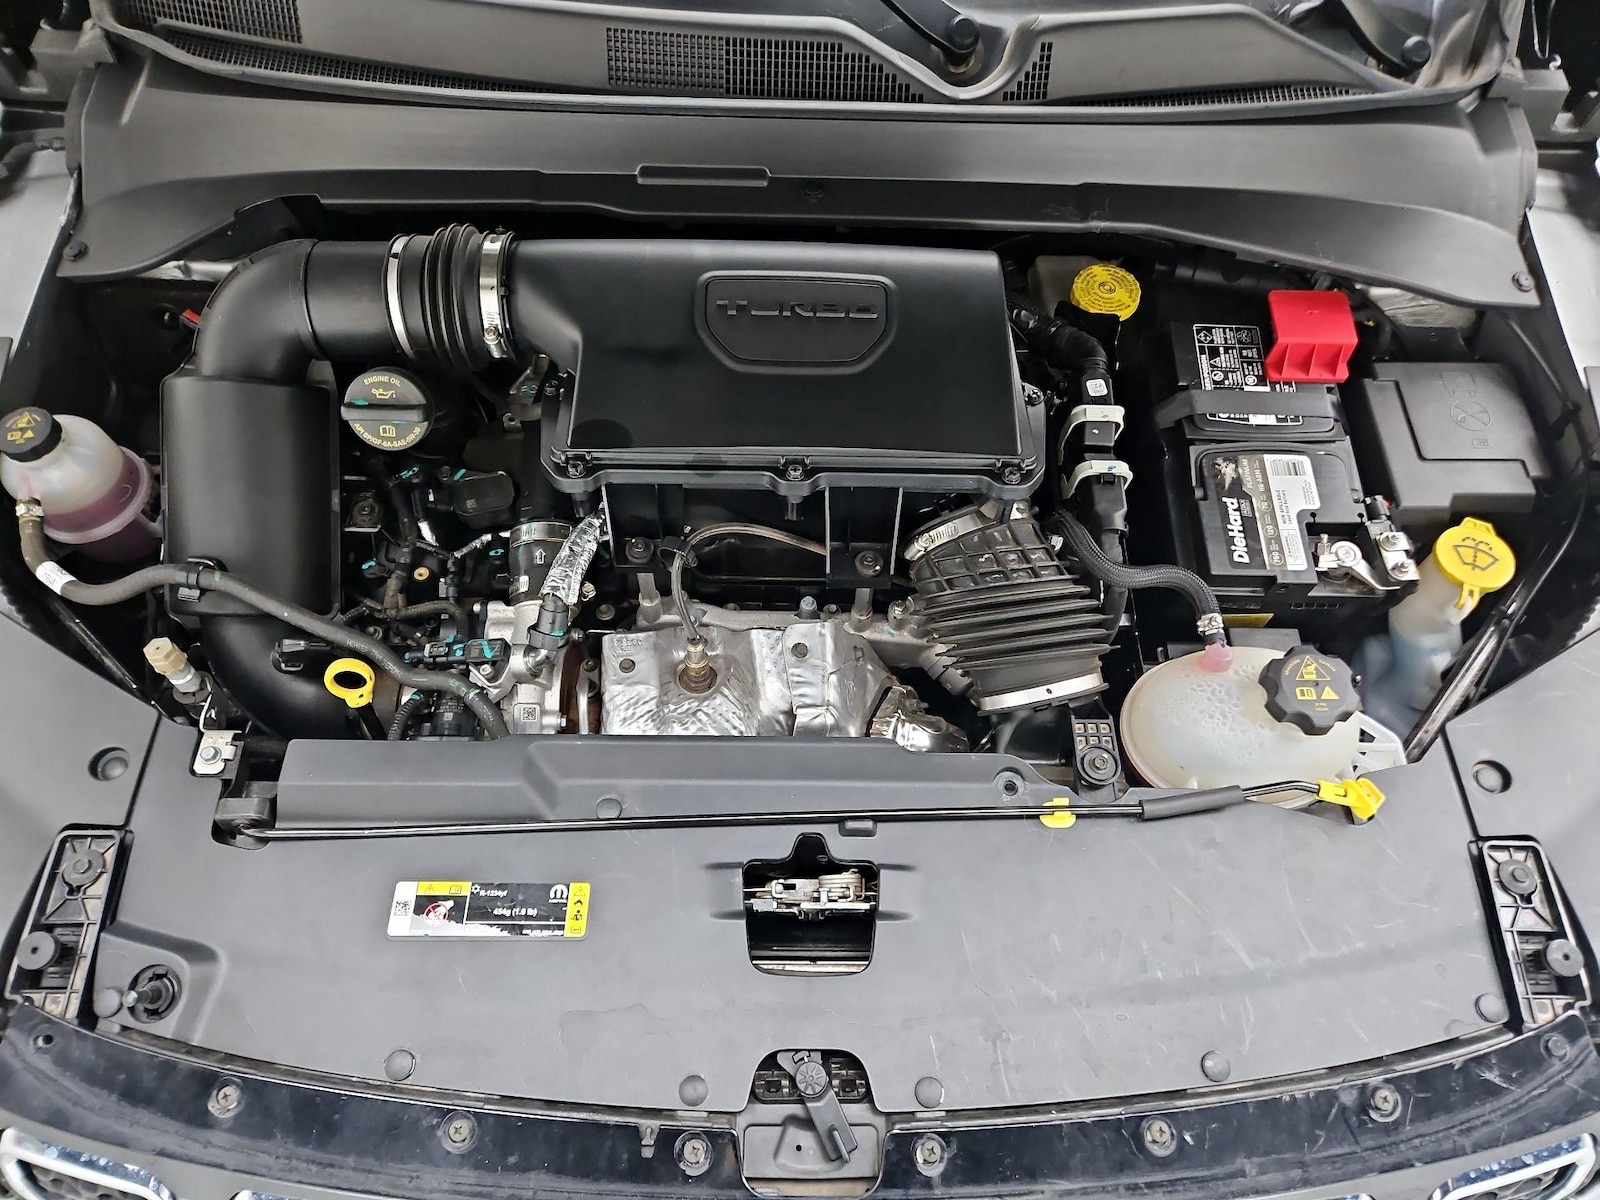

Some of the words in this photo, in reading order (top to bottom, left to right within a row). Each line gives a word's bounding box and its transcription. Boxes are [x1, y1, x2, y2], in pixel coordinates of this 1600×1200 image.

[716, 299, 878, 319] TURBO
[363, 375, 389, 385] ENGINE
[390, 377, 401, 387] OIL
[1242, 459, 1253, 489] PLATINUM
[1221, 496, 1250, 563] DieHard
[492, 907, 511, 917] 454g
[526, 908, 538, 917] lb)
